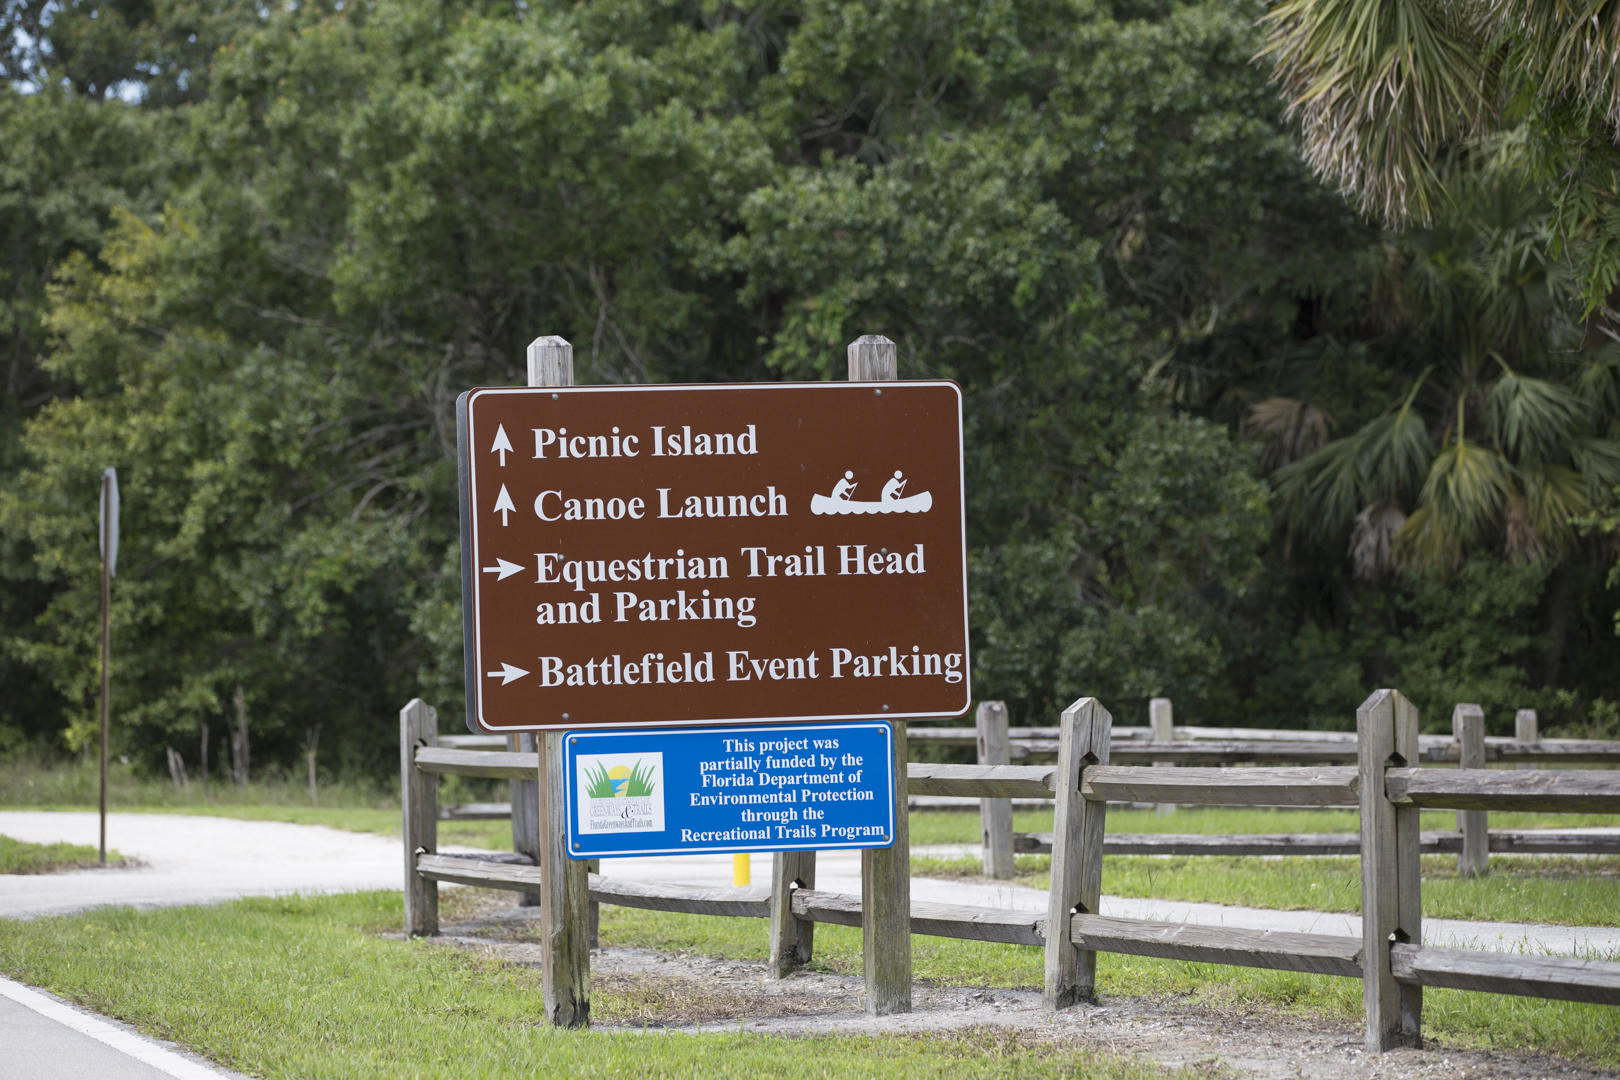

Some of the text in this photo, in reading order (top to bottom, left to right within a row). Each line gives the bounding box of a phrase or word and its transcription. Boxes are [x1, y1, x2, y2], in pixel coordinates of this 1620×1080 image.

[532, 425, 758, 458] Picnic Island
[534, 487, 788, 521] Canoe Launch
[534, 544, 926, 591] Equestrian Trail Head
[537, 590, 756, 627] and Parking
[539, 646, 962, 686] Battlefield Event Parking
[723, 738, 839, 754] This project was
[700, 753, 863, 774] partially funded by the
[702, 770, 863, 788] Florida Department of
[691, 788, 873, 806] Environmental Protection
[742, 807, 824, 824] through the
[682, 824, 884, 842] Recreational Trails Program
